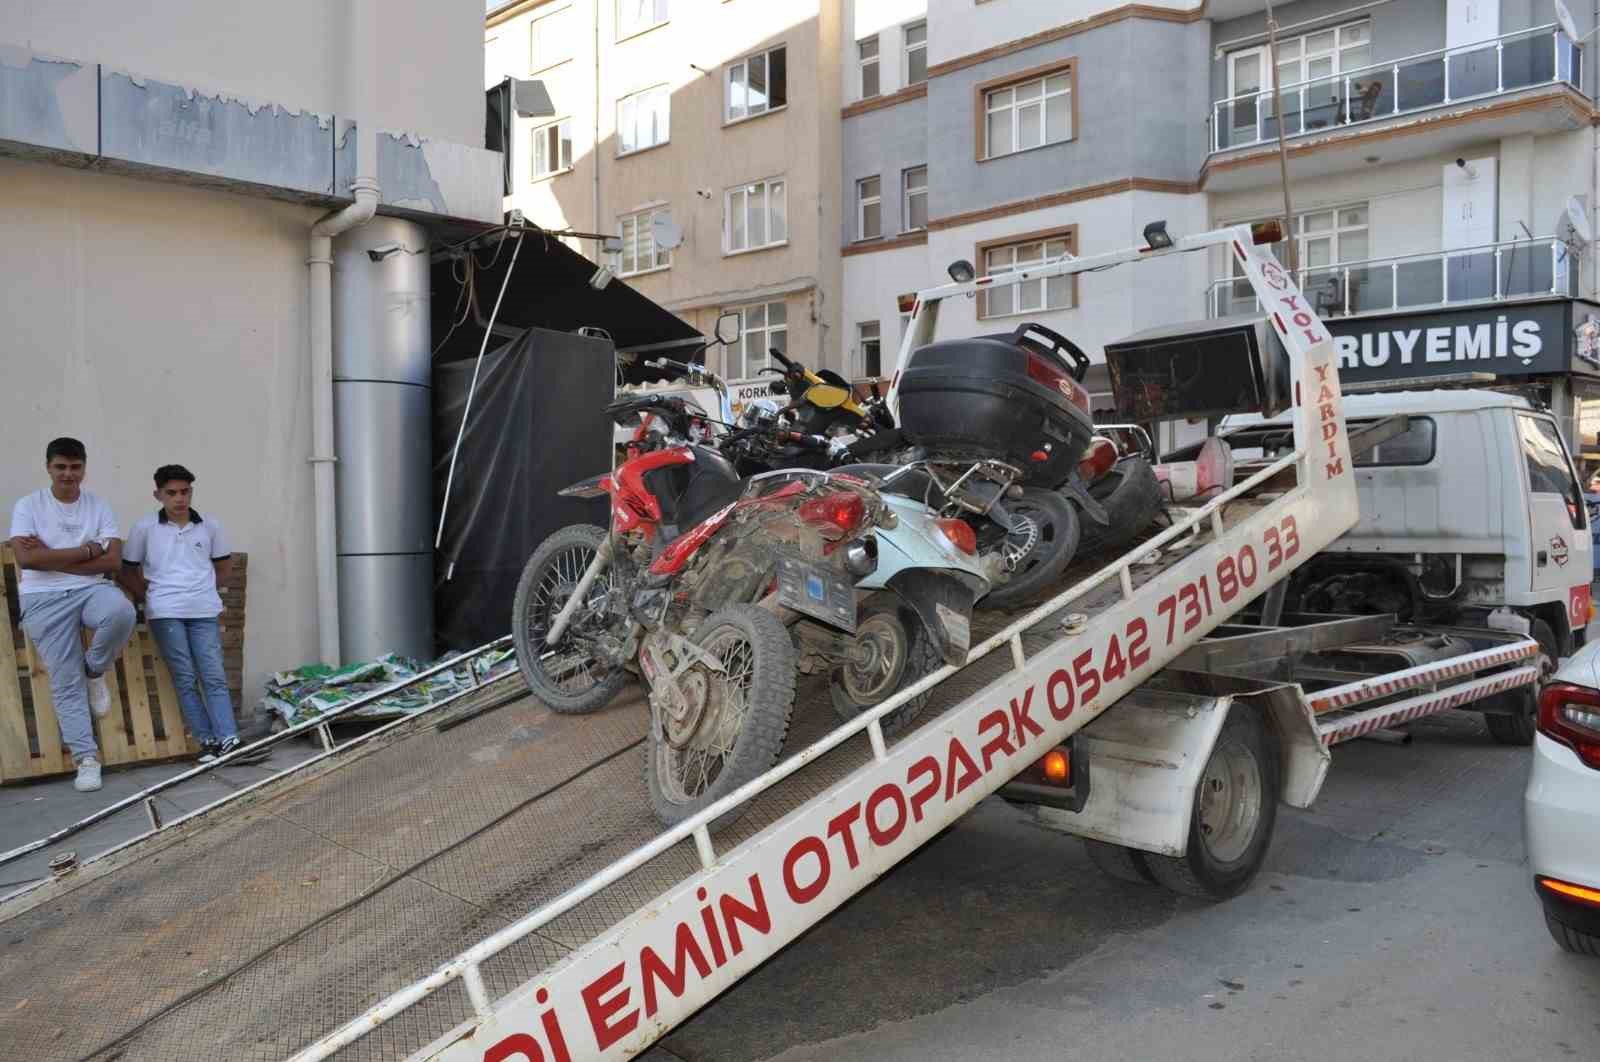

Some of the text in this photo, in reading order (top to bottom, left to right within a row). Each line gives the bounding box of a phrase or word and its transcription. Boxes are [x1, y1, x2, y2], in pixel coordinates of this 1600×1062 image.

[1280, 295, 1323, 345] YOL
[1334, 315, 1543, 368] RUYEMİŞ
[1313, 363, 1344, 481] YARDIM
[581, 875, 773, 1050] EMİN
[783, 687, 1045, 904] OTOPARK
[1045, 618, 1150, 721] 0542
[1157, 573, 1213, 646] 731
[1216, 544, 1258, 604] 80
[1263, 514, 1301, 573] 33
